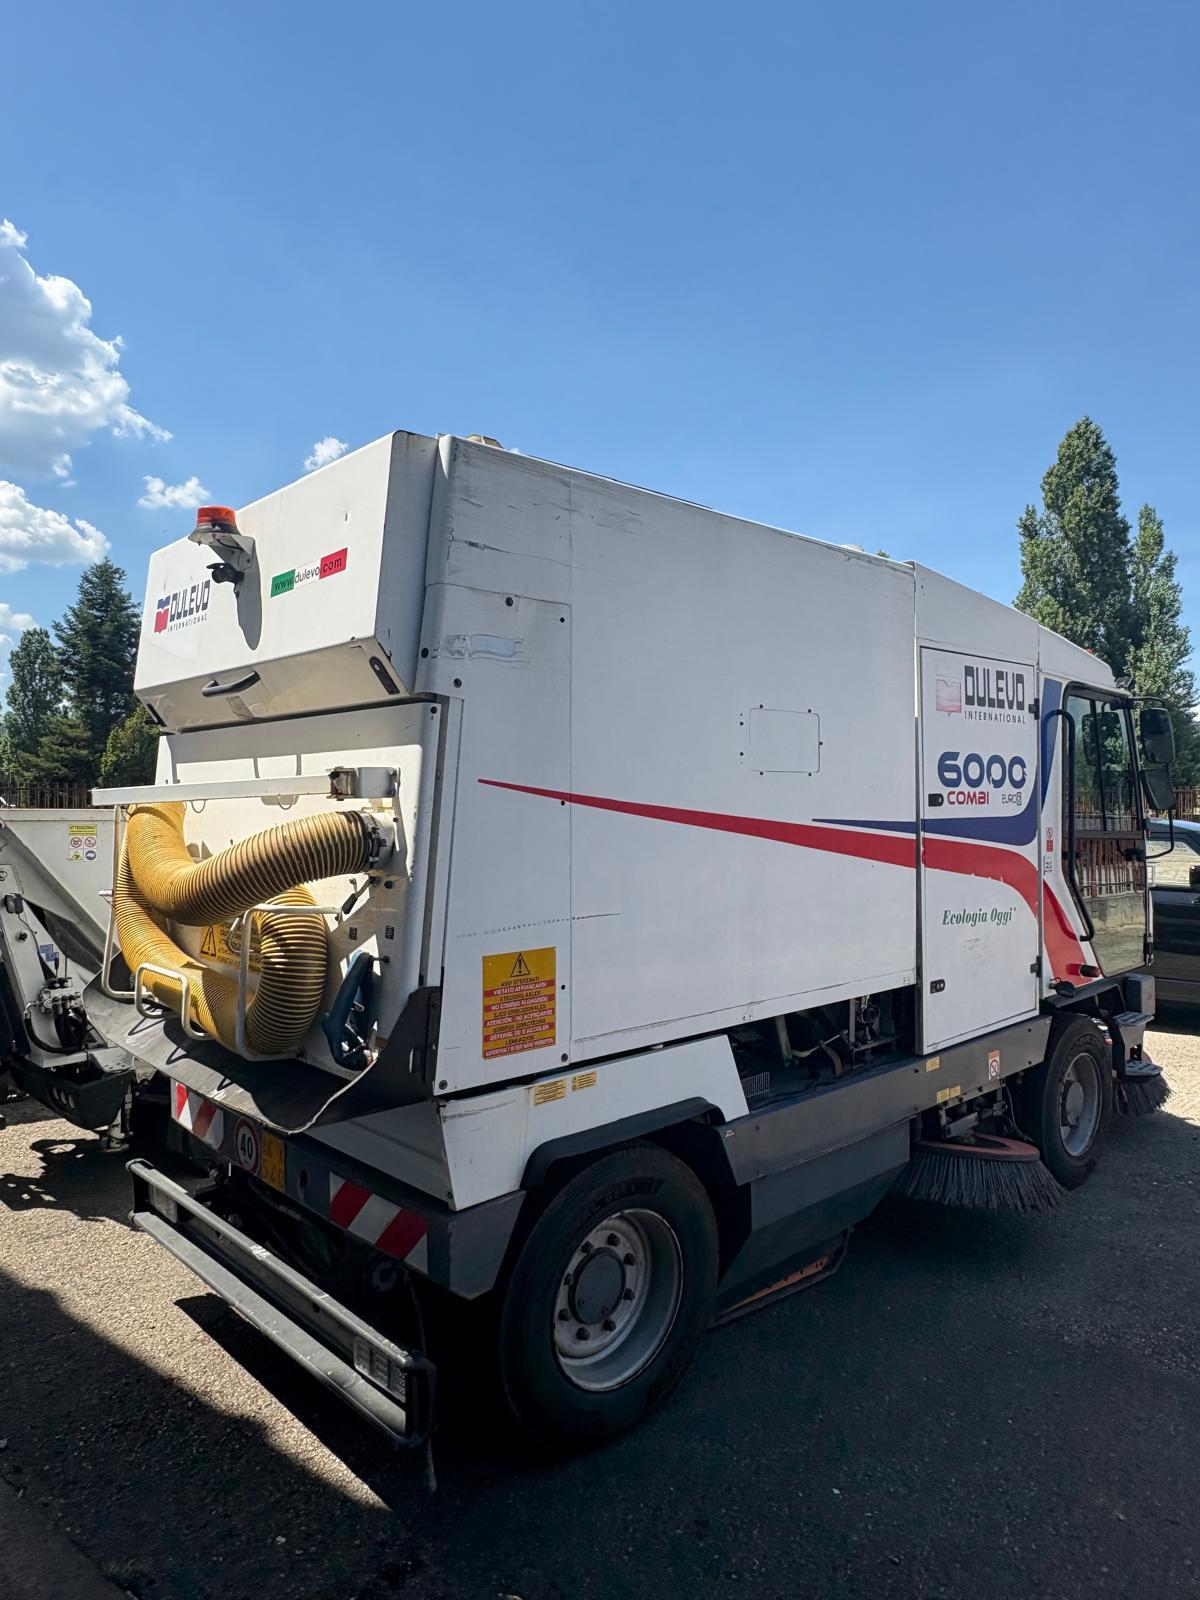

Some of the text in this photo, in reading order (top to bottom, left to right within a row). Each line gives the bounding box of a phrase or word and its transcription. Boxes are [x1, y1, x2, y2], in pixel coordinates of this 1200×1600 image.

[169, 579, 211, 622] DULEVO
[168, 613, 208, 632] INTERNATIONAL
[964, 665, 1025, 711] DULEVO
[964, 710, 1026, 724] INTERNATIONAL
[937, 751, 1027, 789] 6000
[947, 791, 989, 805] COMBI
[942, 908, 988, 927] Ecologia
[240, 1134, 253, 1159] 40
